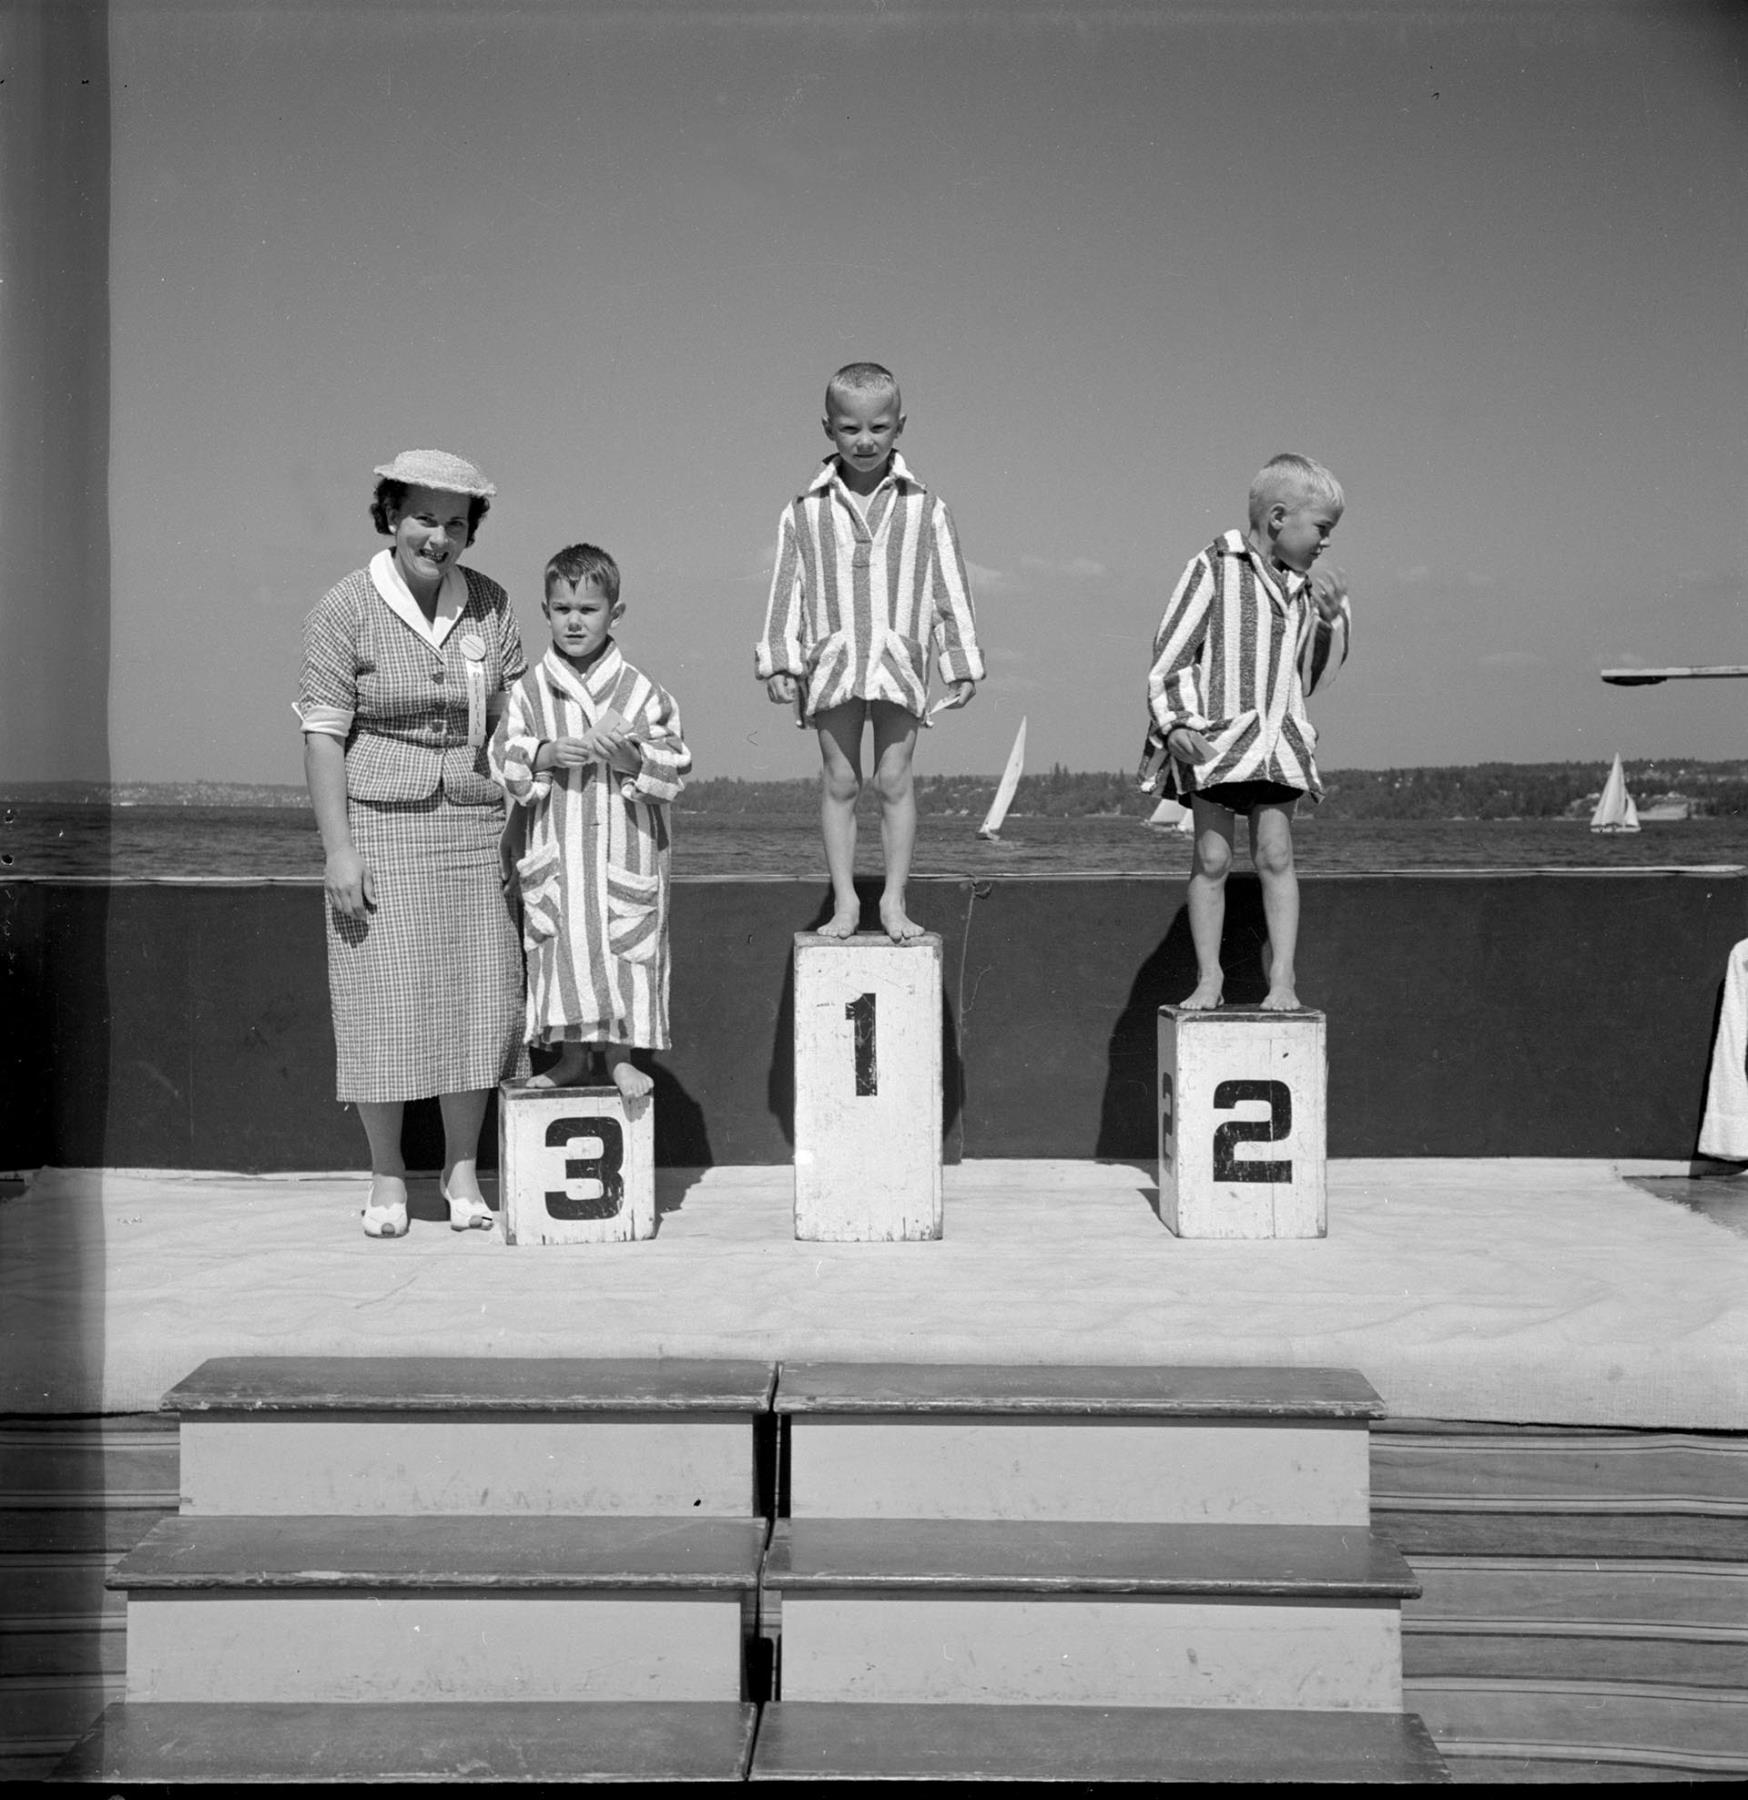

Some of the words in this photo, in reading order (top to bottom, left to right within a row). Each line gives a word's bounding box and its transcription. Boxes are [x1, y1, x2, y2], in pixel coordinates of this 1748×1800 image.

[845, 993, 877, 1096] 1
[545, 1116, 624, 1220] 3
[1163, 1072, 1173, 1177] 2
[1213, 1080, 1292, 1184] 2
